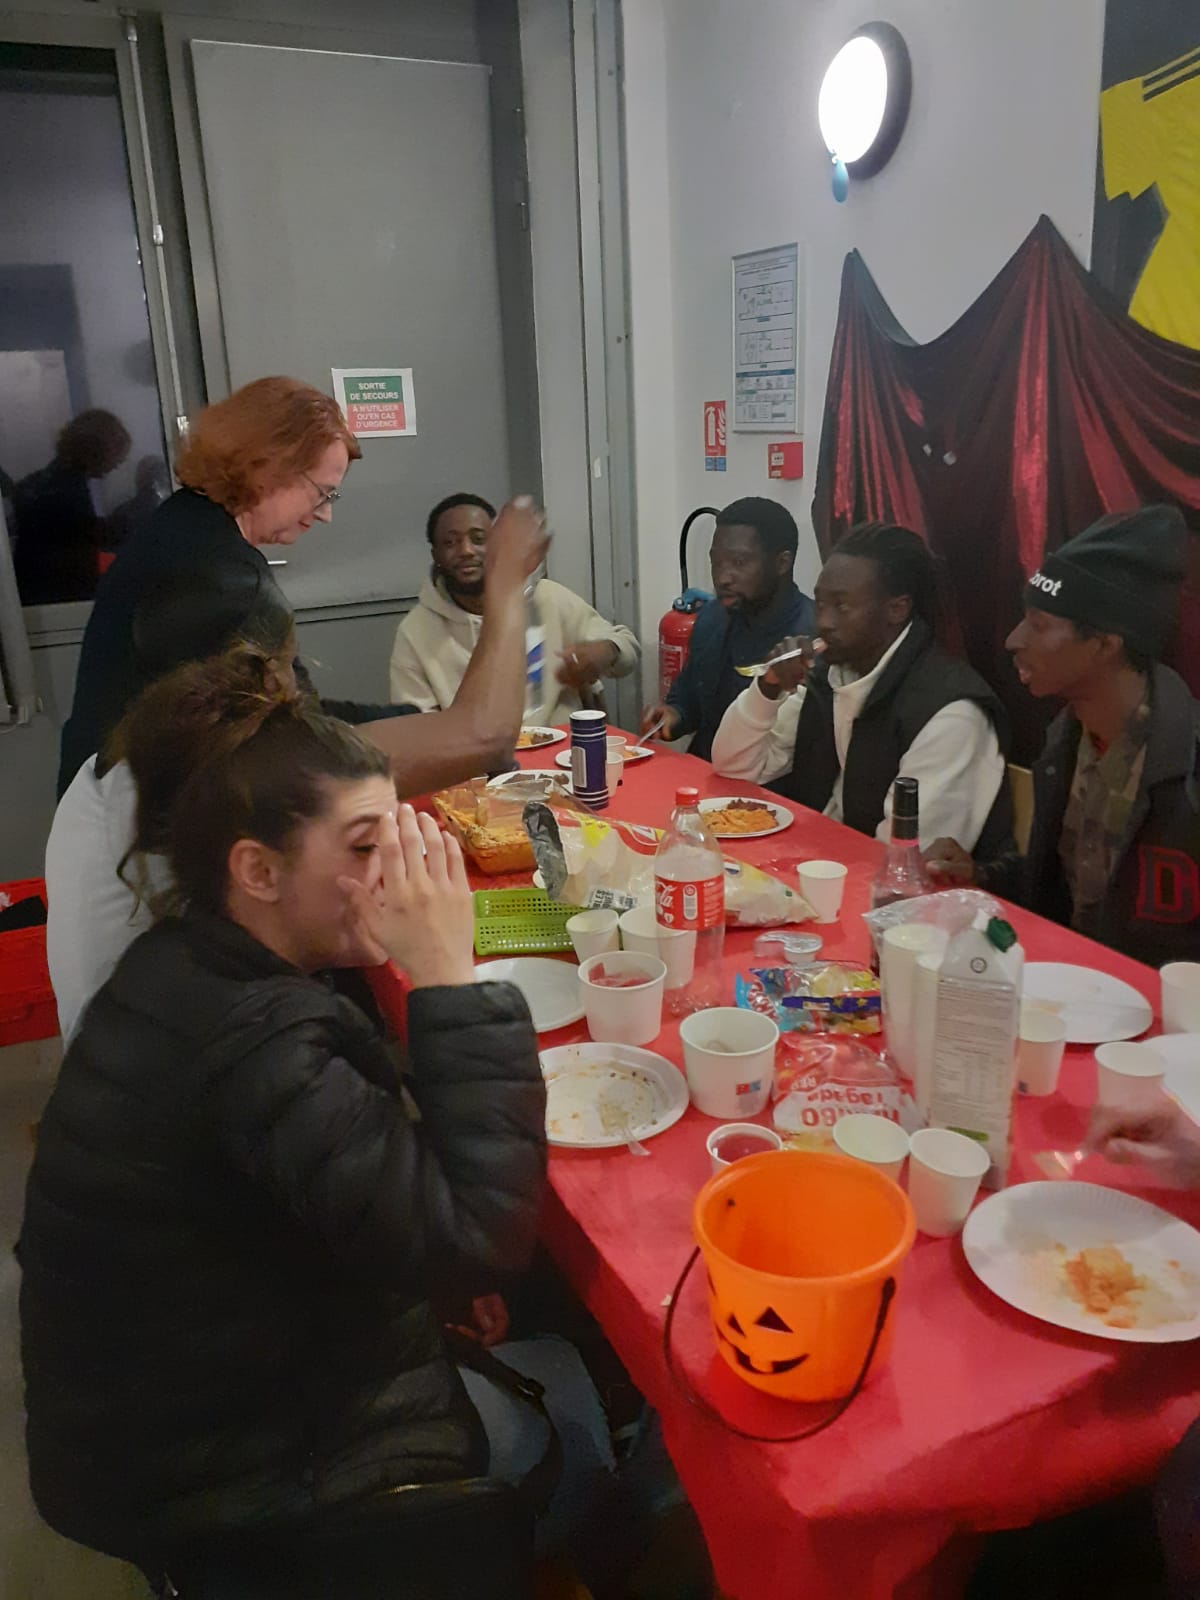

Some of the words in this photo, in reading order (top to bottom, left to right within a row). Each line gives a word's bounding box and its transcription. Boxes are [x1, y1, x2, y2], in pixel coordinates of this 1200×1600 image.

[358, 382, 387, 391] SORTIE
[362, 391, 399, 400] SECOURS
[1136, 845, 1200, 924] D
